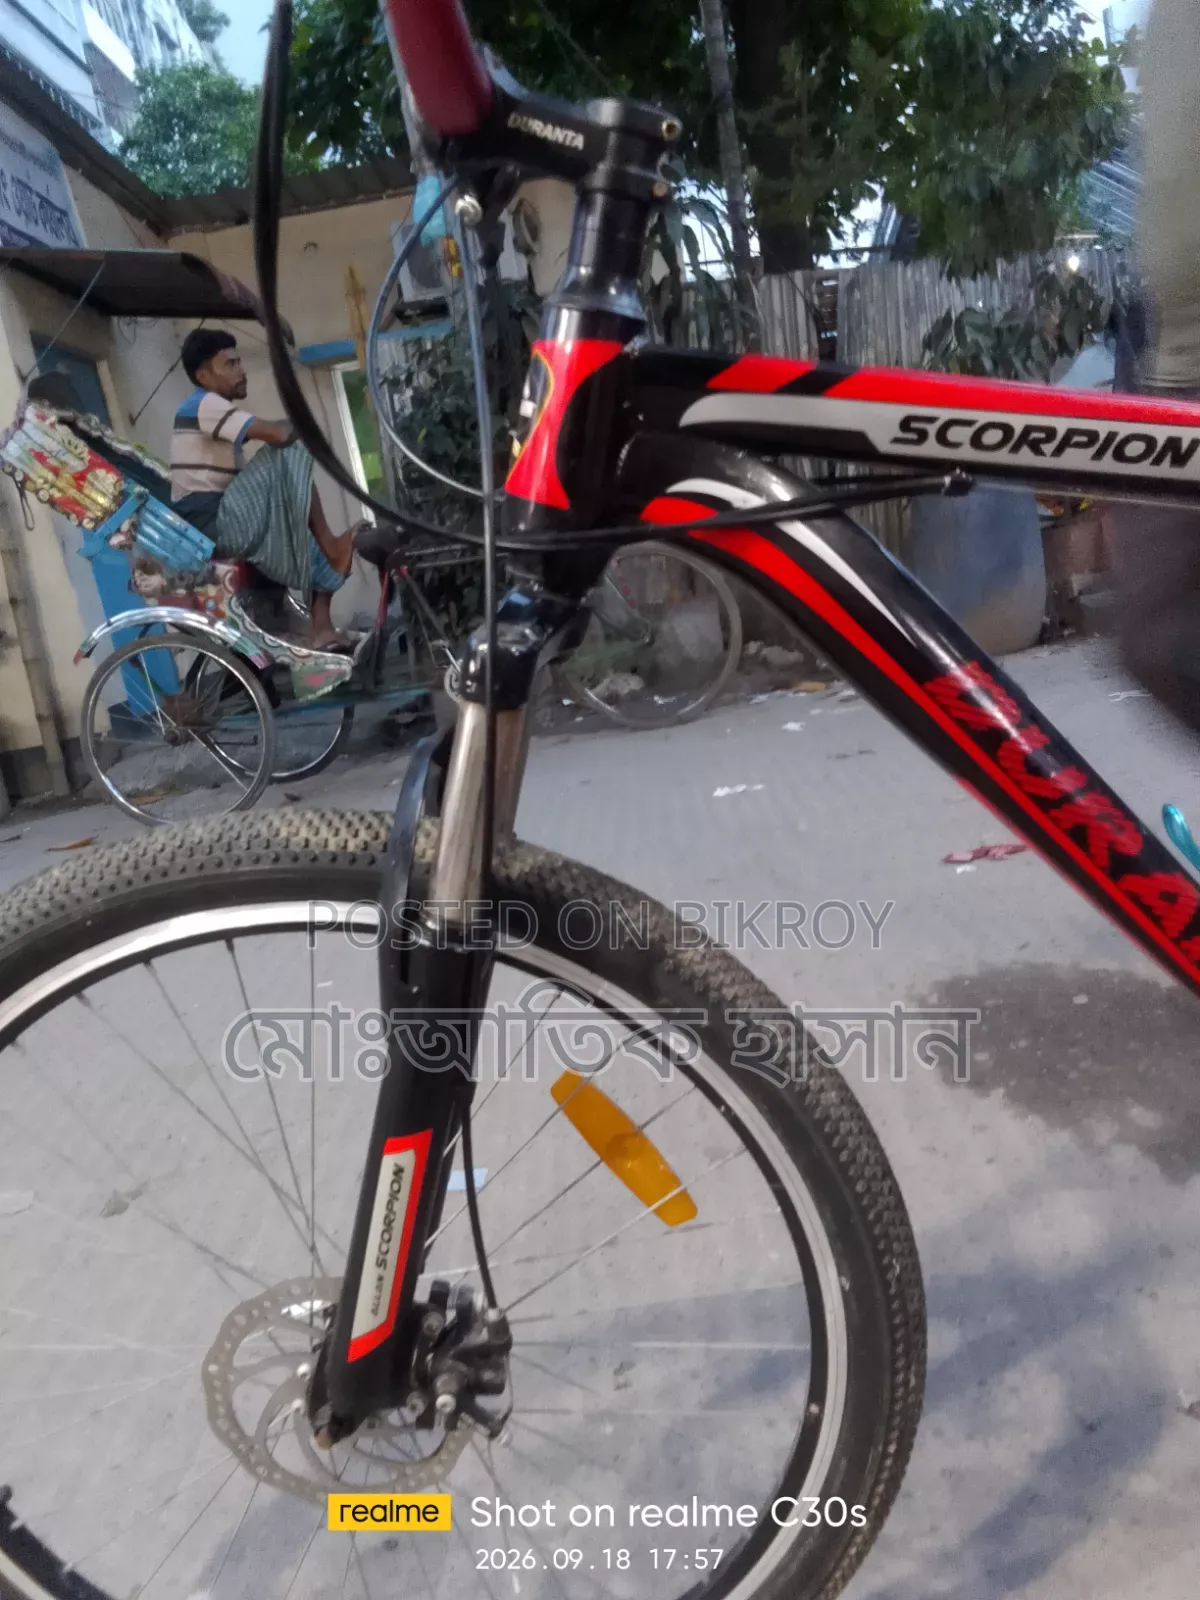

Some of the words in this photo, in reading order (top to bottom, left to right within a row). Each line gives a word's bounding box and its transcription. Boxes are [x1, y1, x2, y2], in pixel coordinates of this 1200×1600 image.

[508, 113, 584, 151] DURANTA
[890, 414, 1199, 468] SCORPION
[923, 661, 1200, 966] DURA
[375, 1162, 406, 1270] SCORPION
